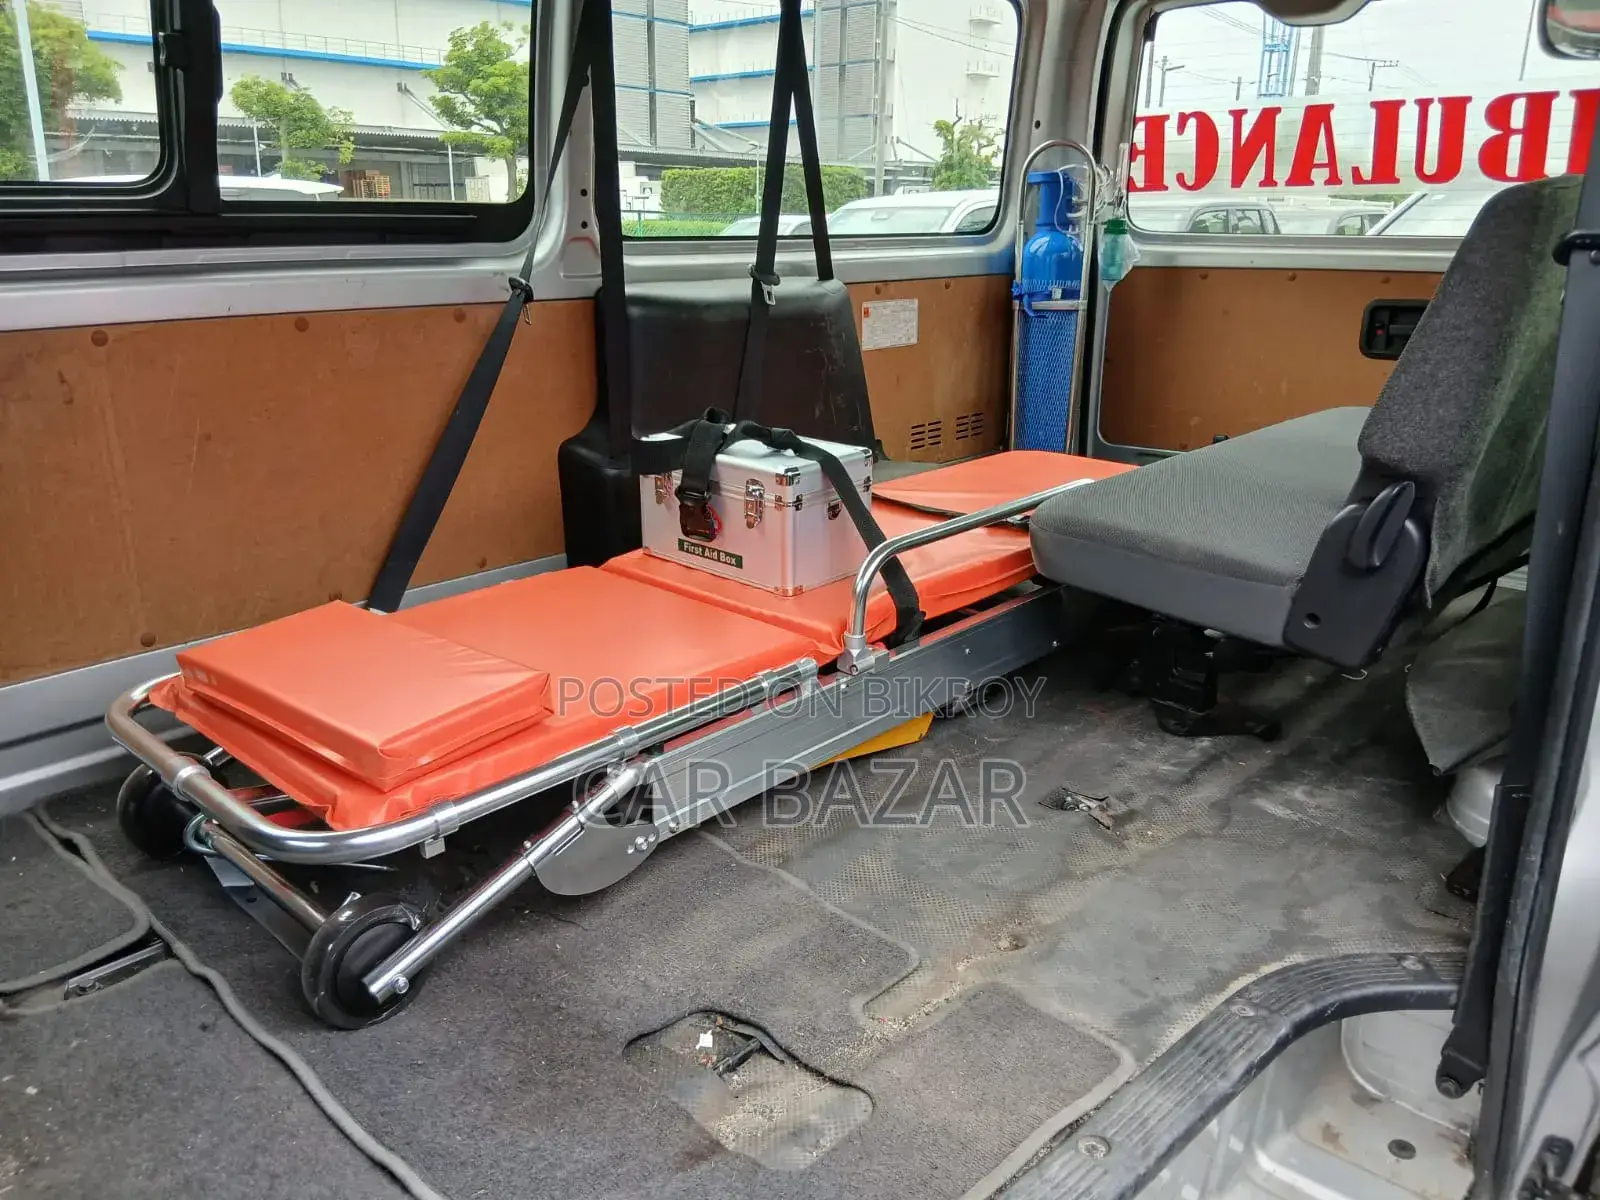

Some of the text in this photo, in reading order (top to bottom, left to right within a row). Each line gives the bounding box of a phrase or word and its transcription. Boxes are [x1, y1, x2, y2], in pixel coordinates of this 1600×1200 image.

[683, 541, 737, 565] First Aid Box
